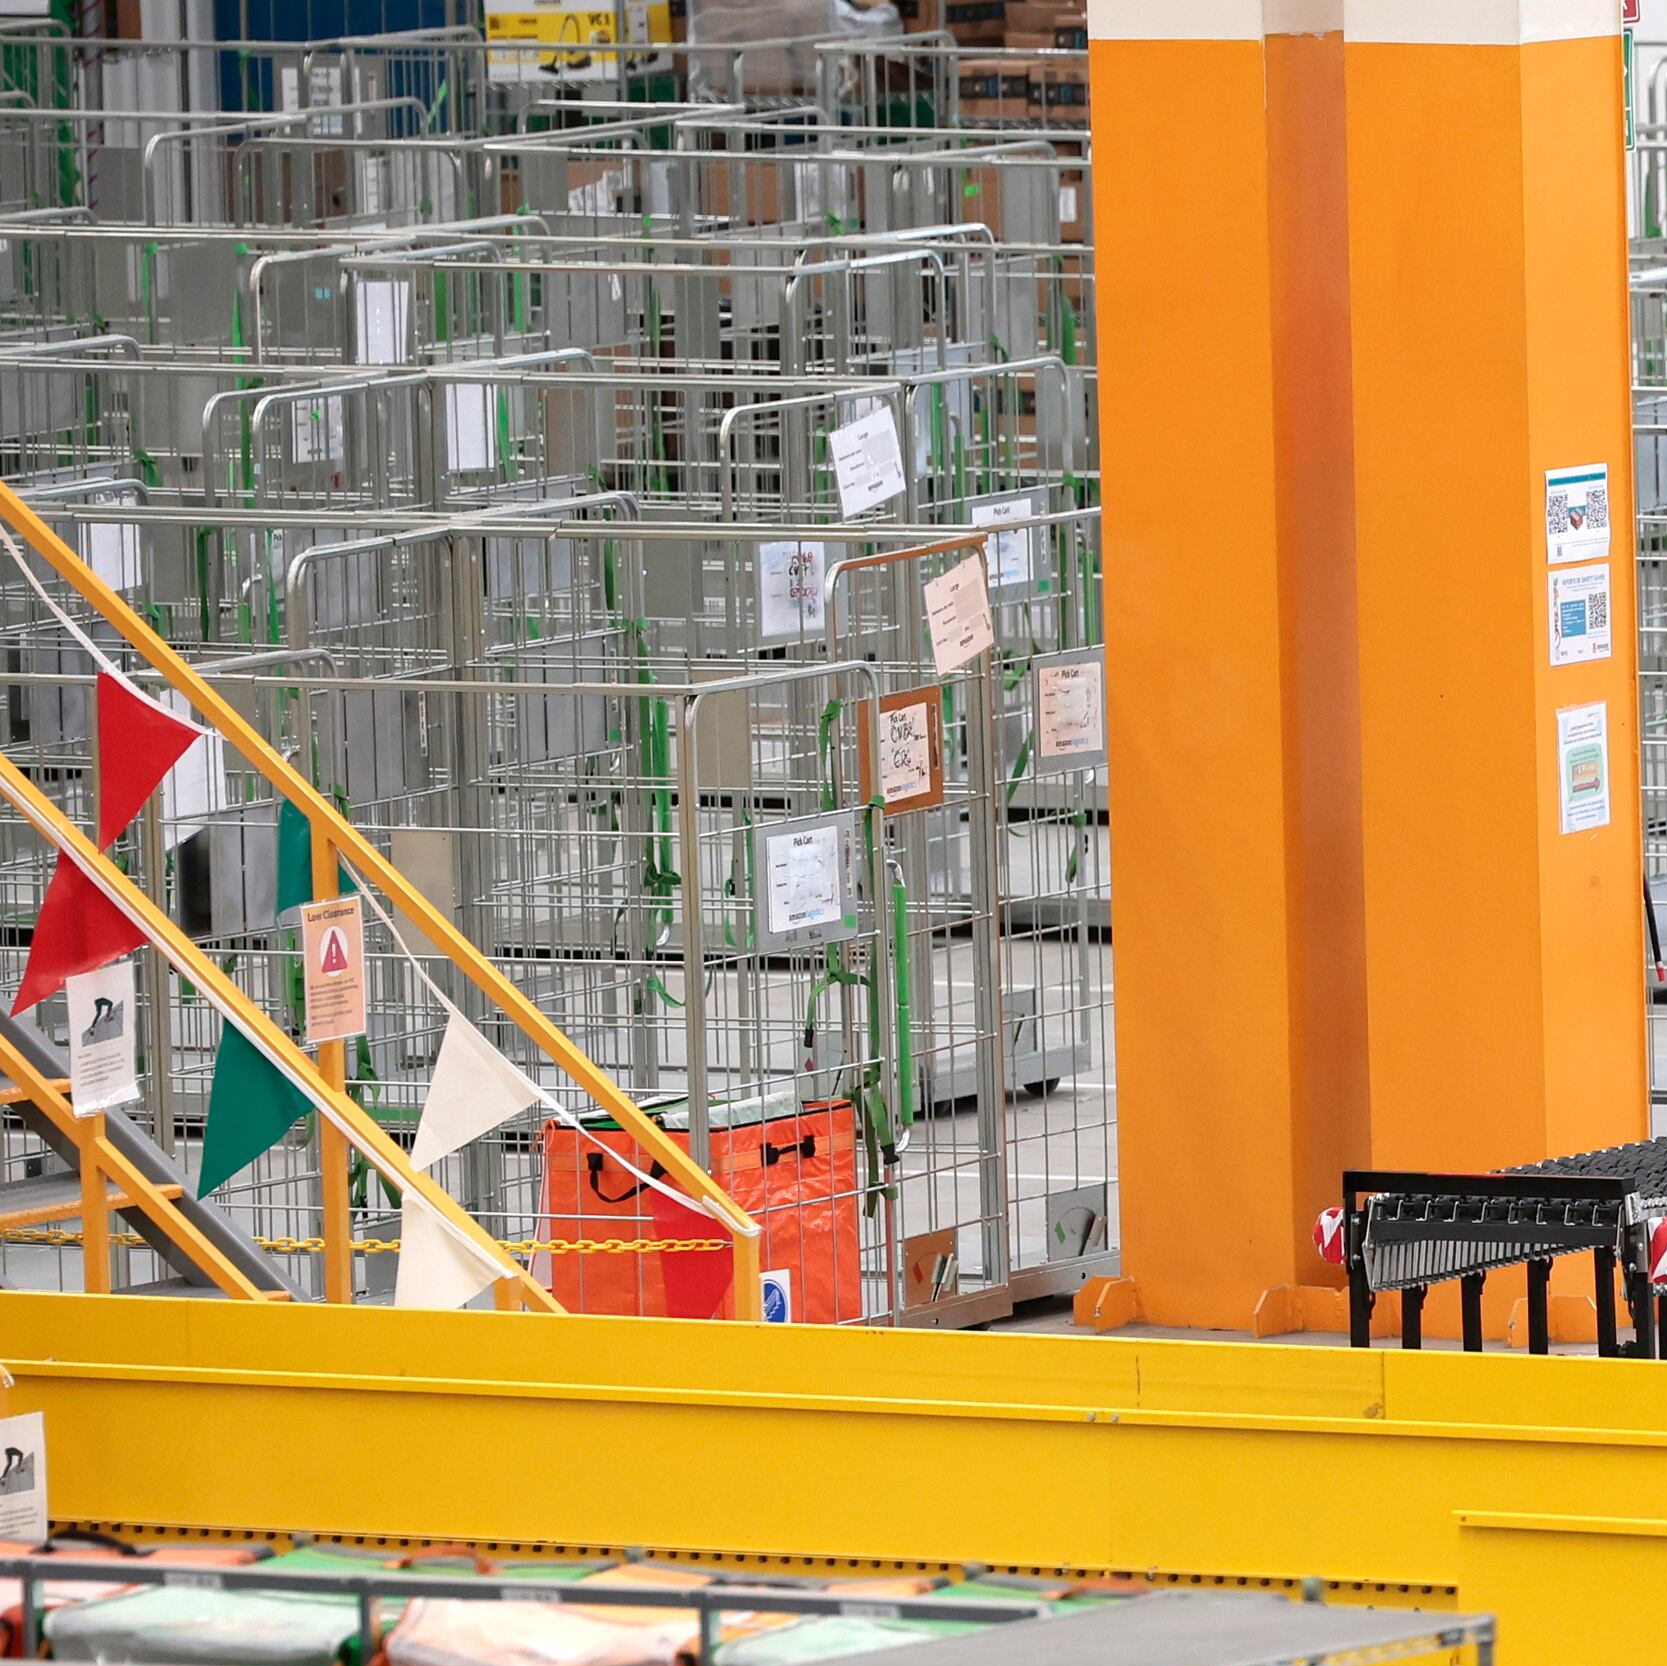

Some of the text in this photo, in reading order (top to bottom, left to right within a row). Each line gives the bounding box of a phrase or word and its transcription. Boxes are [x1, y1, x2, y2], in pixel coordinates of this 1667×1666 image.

[793, 836, 813, 846] Pick Cart
[307, 907, 355, 922] Low Clearance
